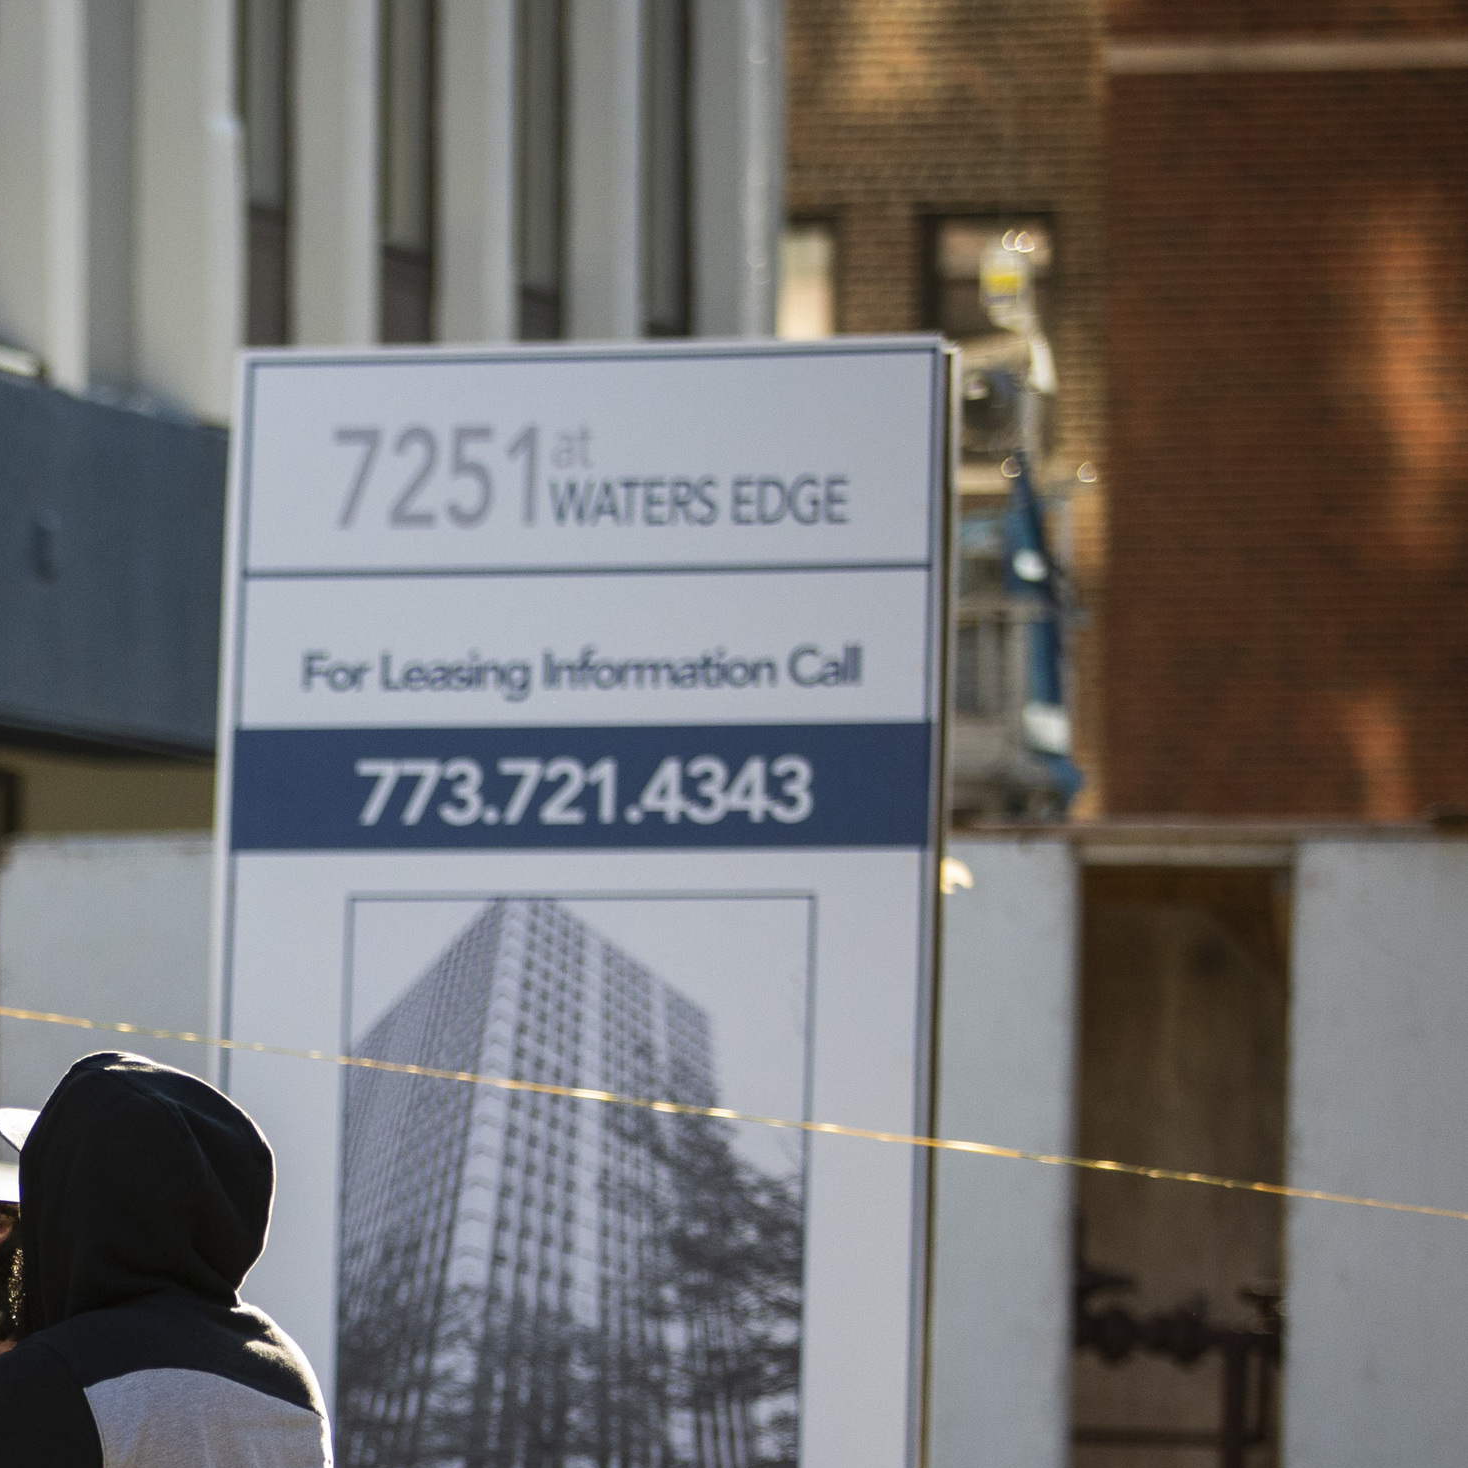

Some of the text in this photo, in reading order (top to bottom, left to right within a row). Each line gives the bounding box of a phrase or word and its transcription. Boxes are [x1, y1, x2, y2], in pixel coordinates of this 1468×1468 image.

[550, 424, 594, 470] at
[333, 423, 541, 530] 7251
[548, 473, 851, 526] WATERS EDGE
[301, 644, 863, 702] For Leasing Information Call
[355, 753, 815, 827] 773.721.4343
